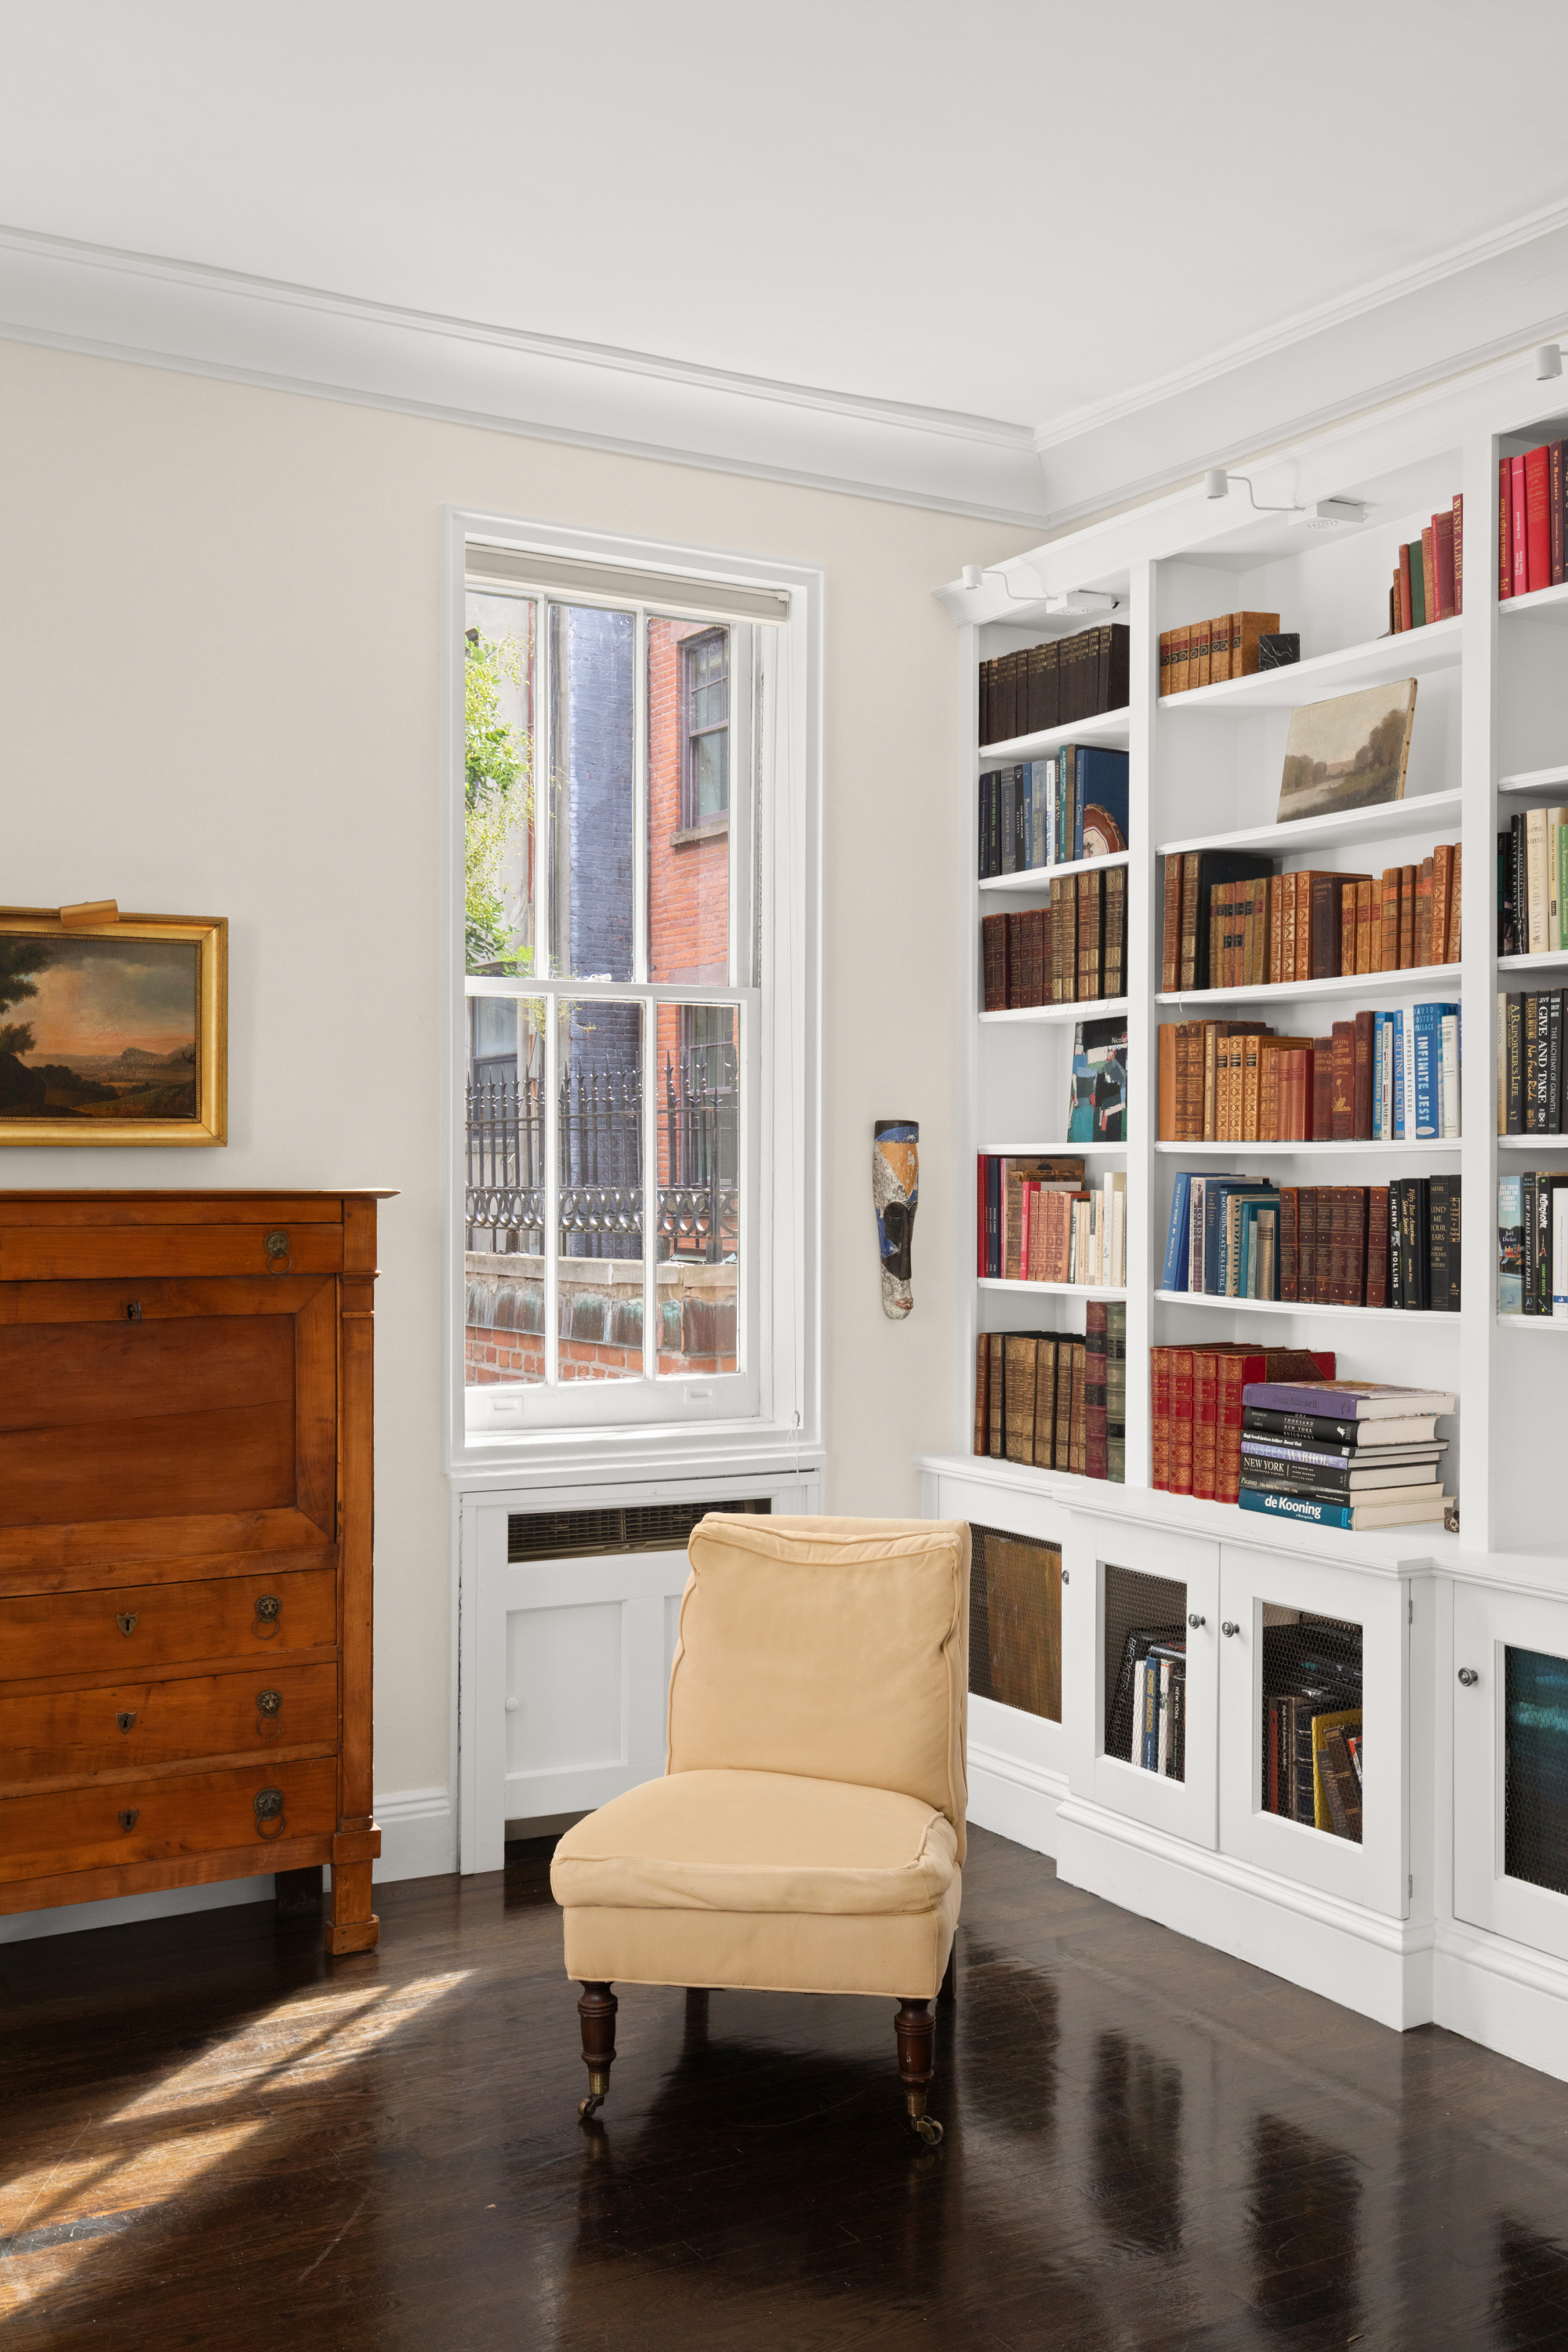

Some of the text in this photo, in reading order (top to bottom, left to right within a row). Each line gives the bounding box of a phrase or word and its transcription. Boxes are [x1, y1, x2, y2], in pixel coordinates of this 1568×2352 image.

[1527, 472, 1544, 481] HISTORY
[1528, 466, 1543, 475] SECRET
[1532, 878, 1541, 909] GORE
[1527, 998, 1537, 1040] KWEISI MFUME
[1417, 1036, 1429, 1090] INFINITE
[1537, 1006, 1548, 1104] GIVE AND TAKE
[1527, 1044, 1537, 1102] No Free Ride
[1550, 1073, 1556, 1082] OF
[1418, 1094, 1429, 1121] JEST
[1221, 1240, 1226, 1249] AT
[1290, 1397, 1317, 1408] Mitchell
[1284, 1417, 1314, 1426] THOUSAND
[1283, 1432, 1314, 1440] BUILDINGS
[1243, 1443, 1286, 1458] UNSEEN
[1287, 1450, 1329, 1466] WARHOL
[1243, 1457, 1285, 1472] NEW YORK
[1241, 1477, 1257, 1486] Picasso
[1265, 1494, 1277, 1508] de
[1279, 1497, 1322, 1519] Kooning
[1120, 1636, 1138, 1690] BECKER
[1145, 1697, 1154, 1733] AMERICA
[1320, 1769, 1341, 1809] MARTHA
